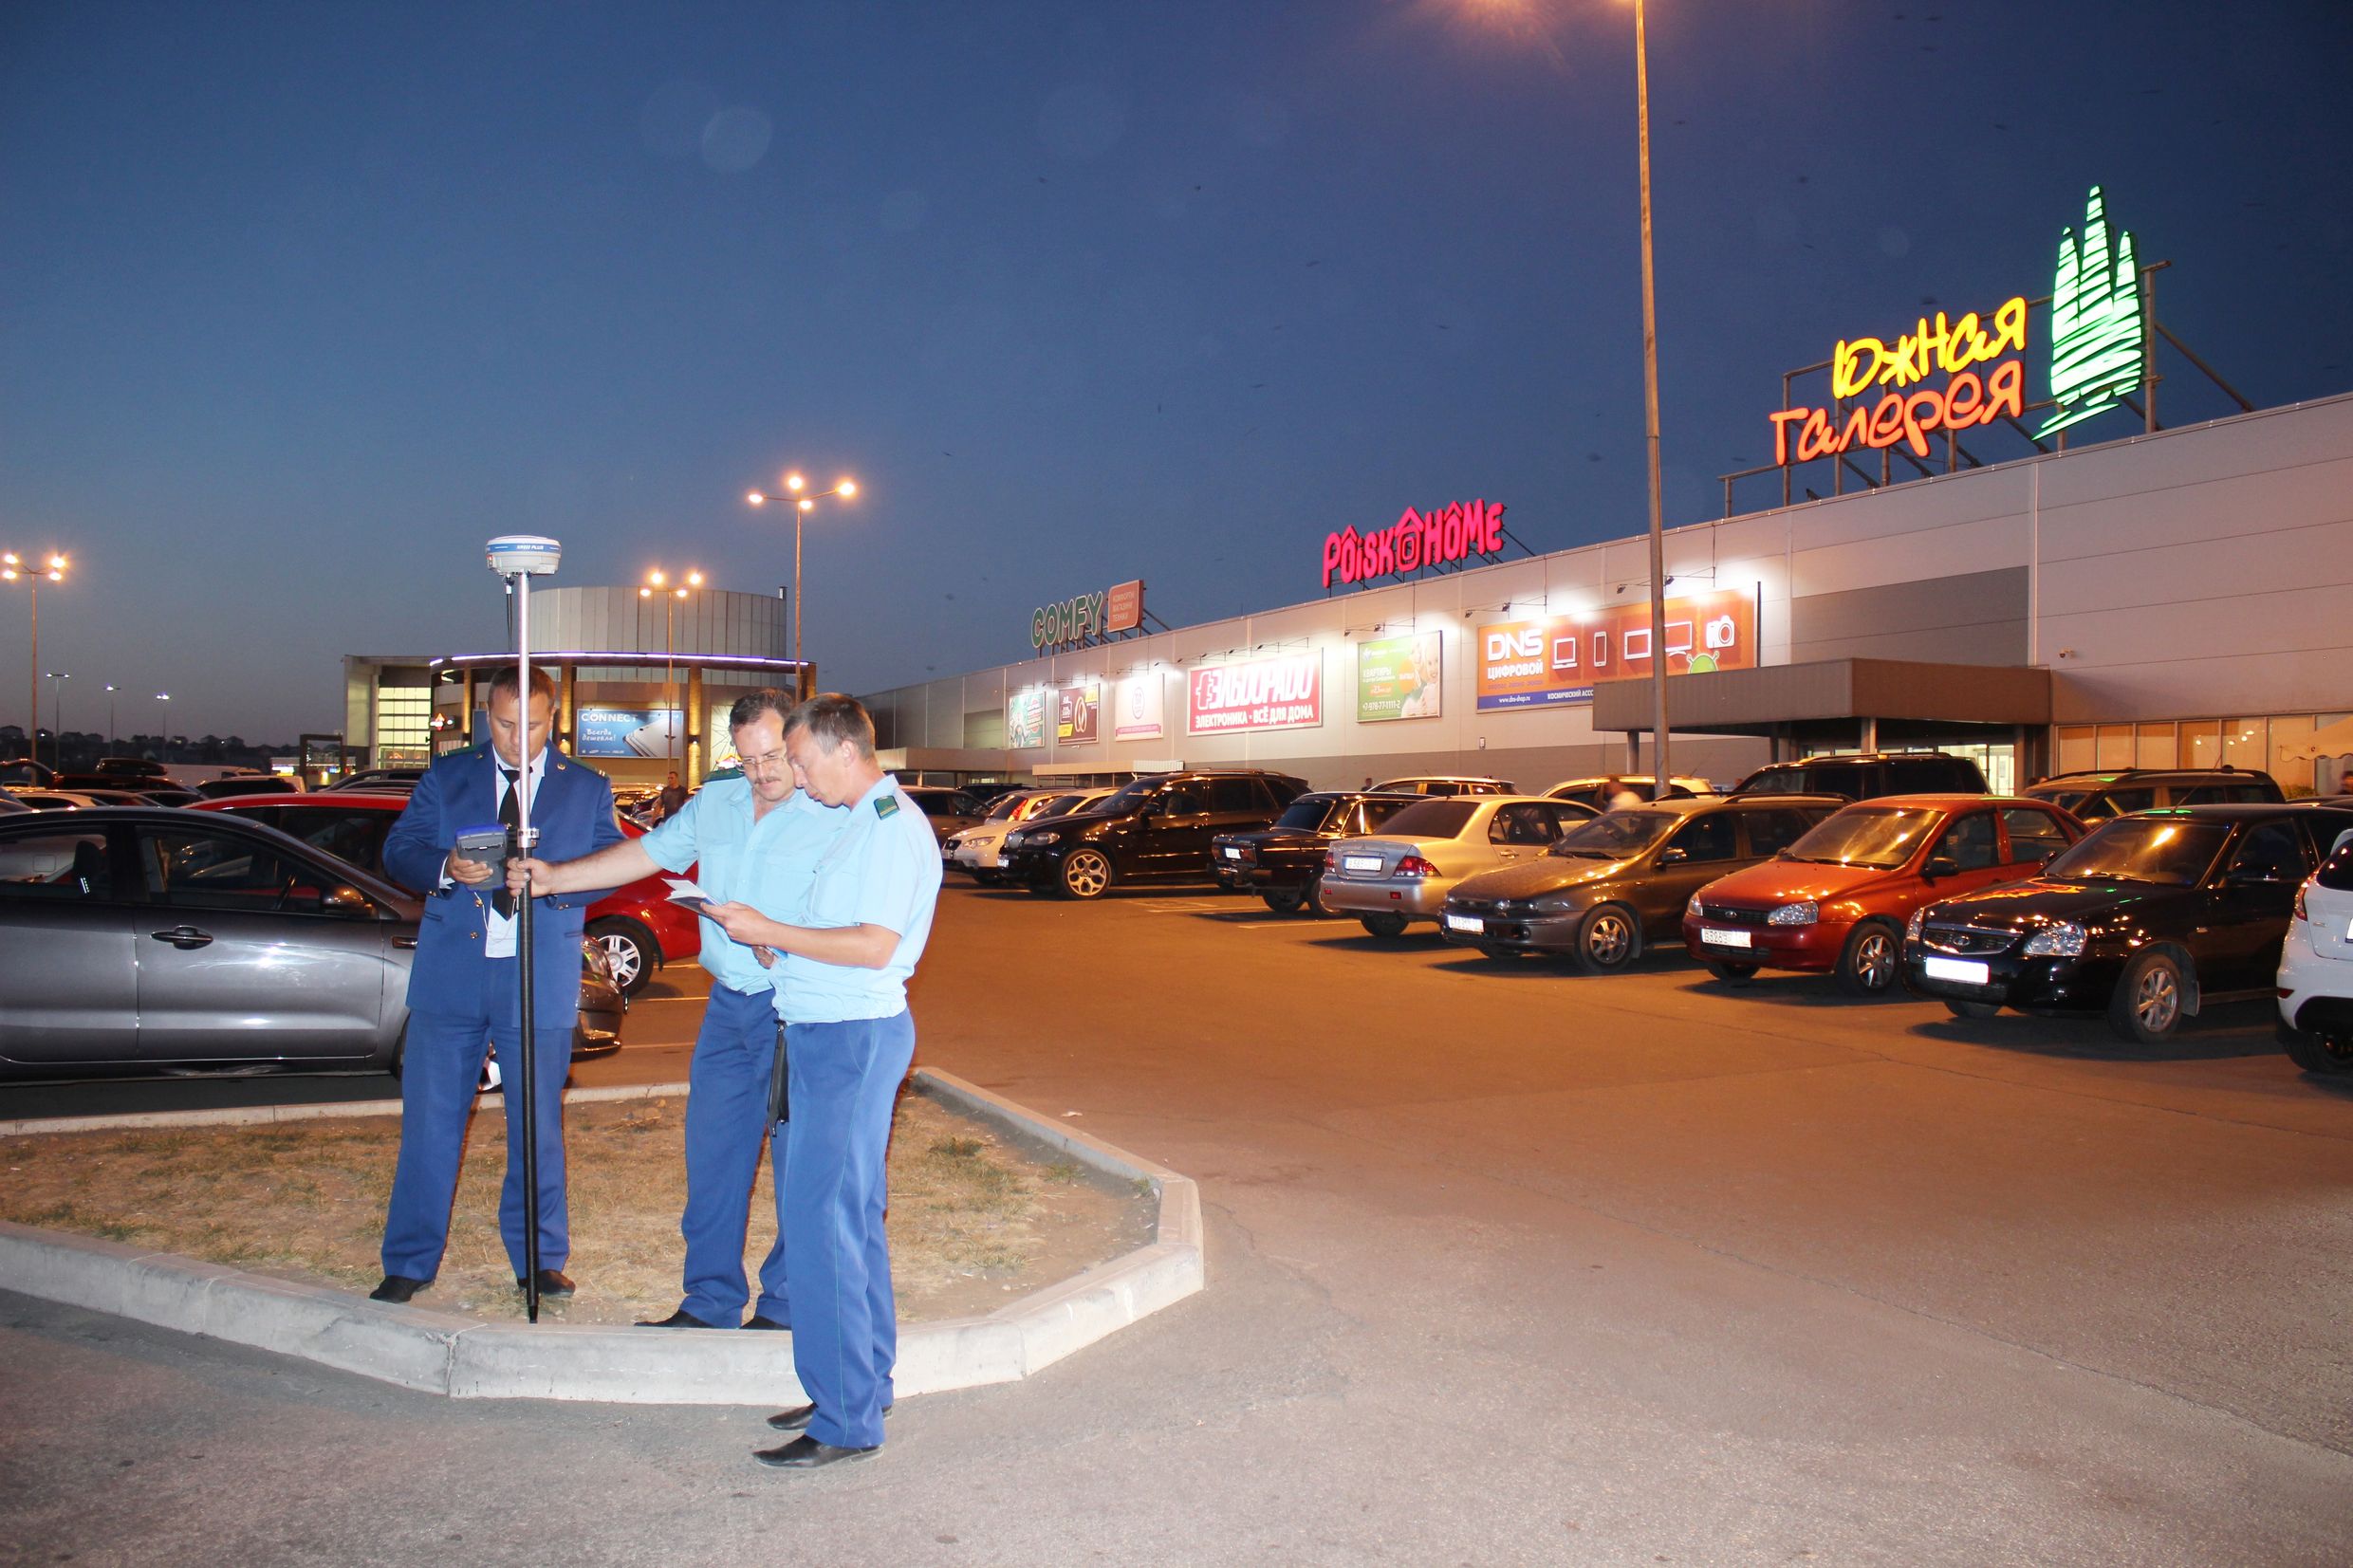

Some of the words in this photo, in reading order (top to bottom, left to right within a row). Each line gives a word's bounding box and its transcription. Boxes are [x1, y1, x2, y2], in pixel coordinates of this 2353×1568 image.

[1769, 360, 2024, 466] Галерея
[1031, 591, 1102, 649] COMFY
[1488, 629, 1544, 661] DNS
[1488, 659, 1544, 681] ЦИФРОВОЙ
[582, 713, 638, 722] CONNECT
[1195, 710, 1248, 729] ЭЛЕКТРОНИКА
[1253, 706, 1269, 724] ВСЁ
[1269, 707, 1287, 725] ДЛЯ
[1288, 705, 1314, 724] ДОМА
